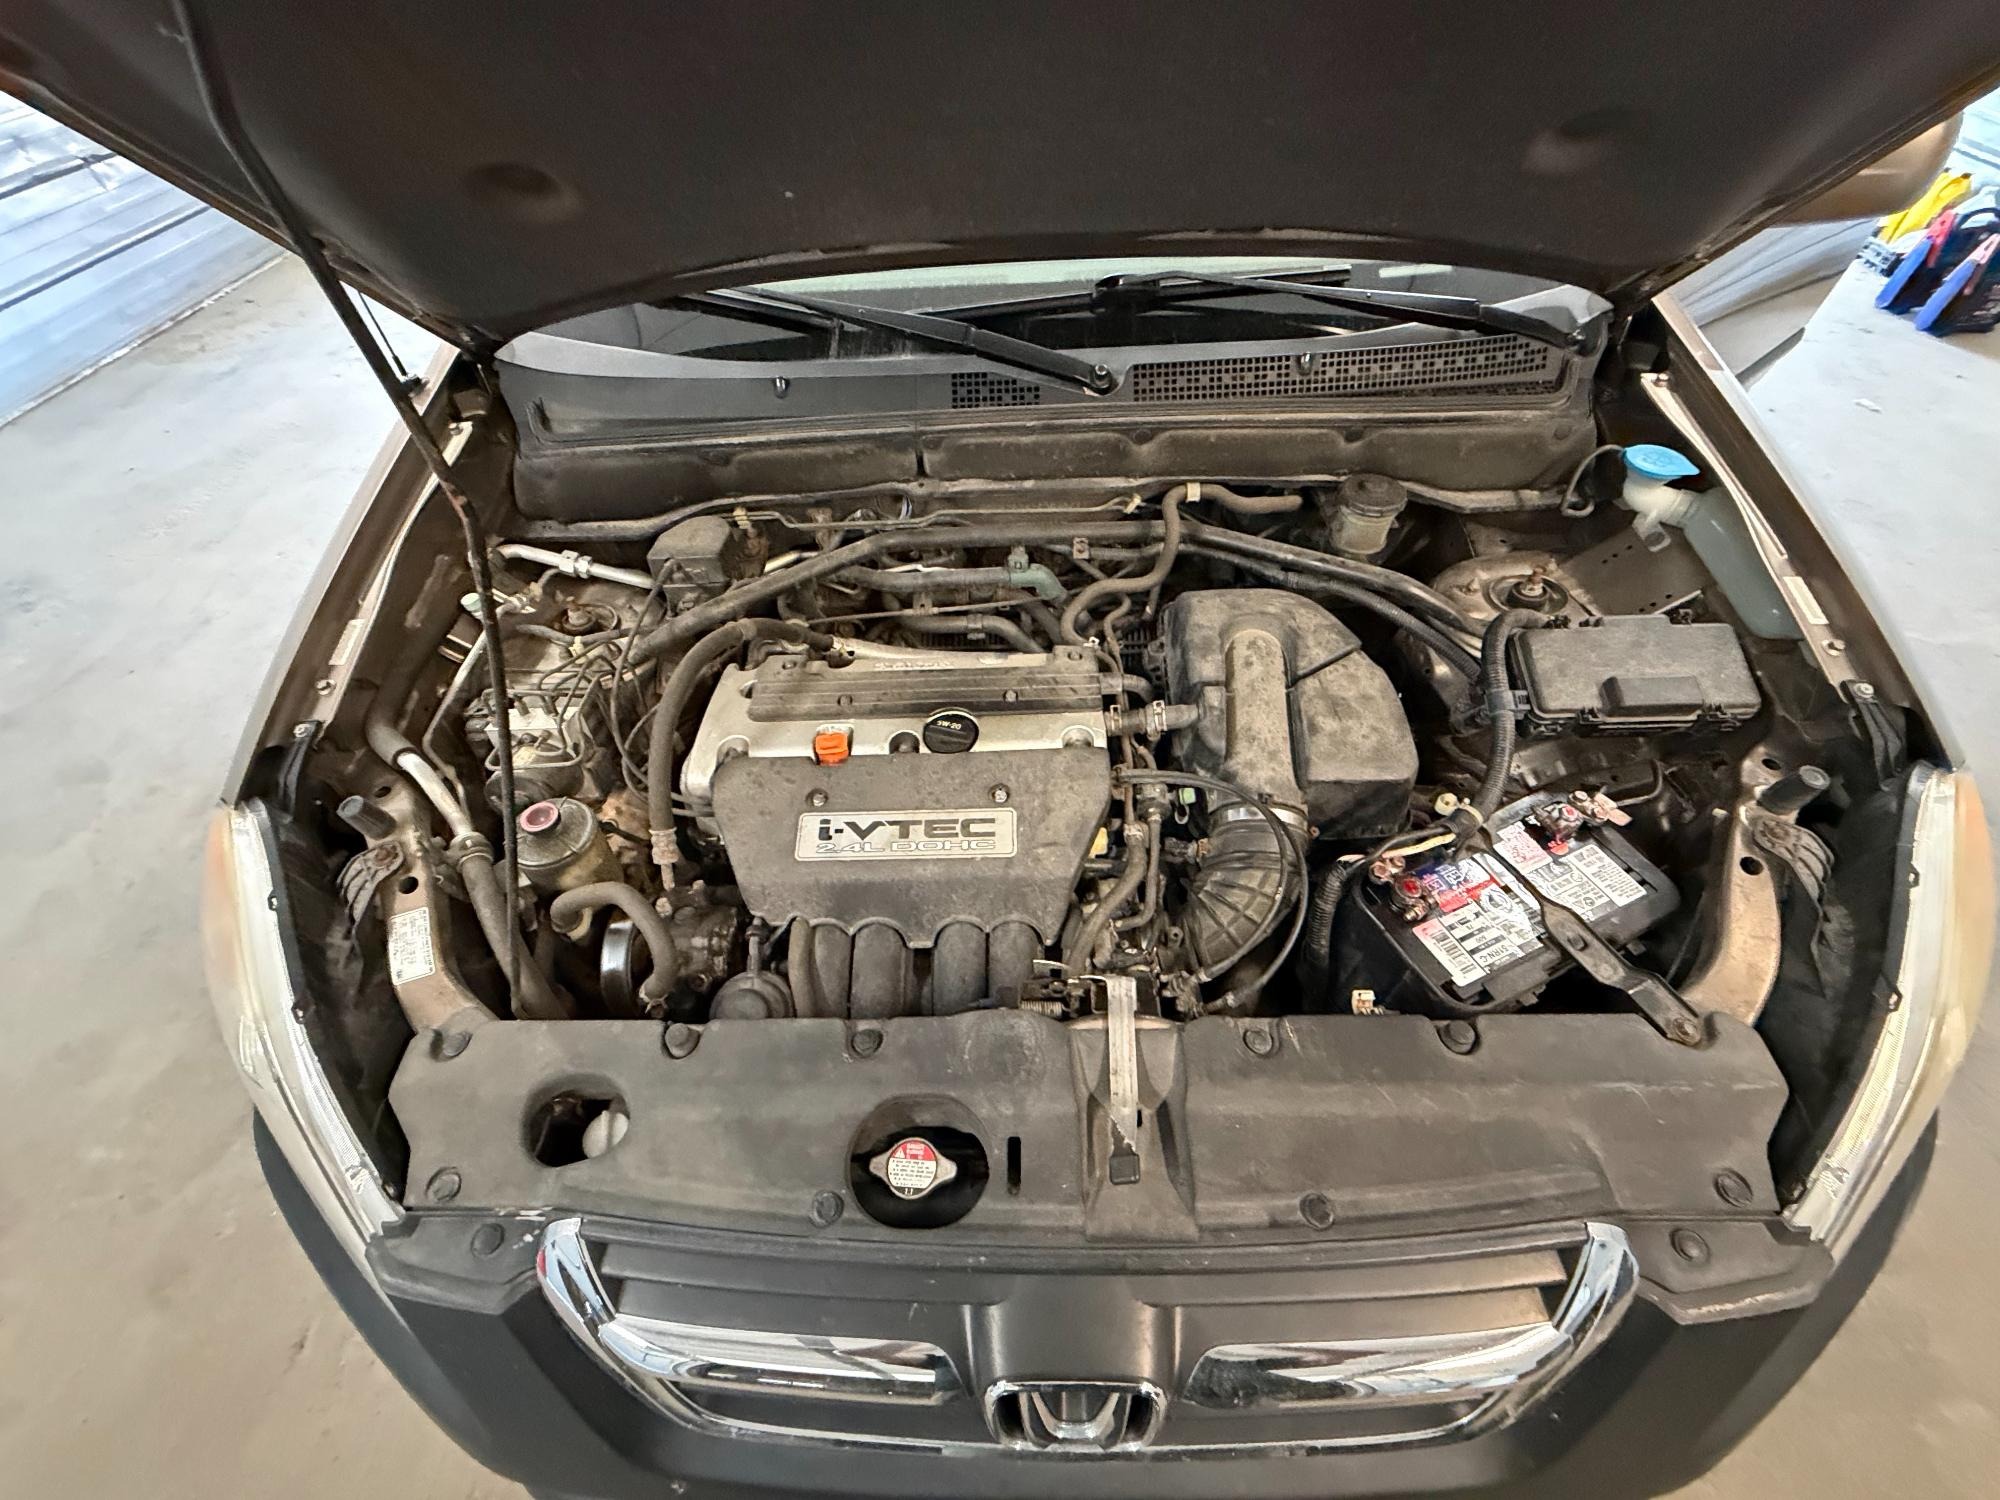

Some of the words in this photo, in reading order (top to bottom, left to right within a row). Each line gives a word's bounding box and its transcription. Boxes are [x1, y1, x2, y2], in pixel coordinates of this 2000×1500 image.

[936, 720, 962, 730] 5W-20
[818, 818, 996, 841] i-VTEC
[816, 841, 885, 853] 2.4L
[890, 840, 996, 851] DOHC
